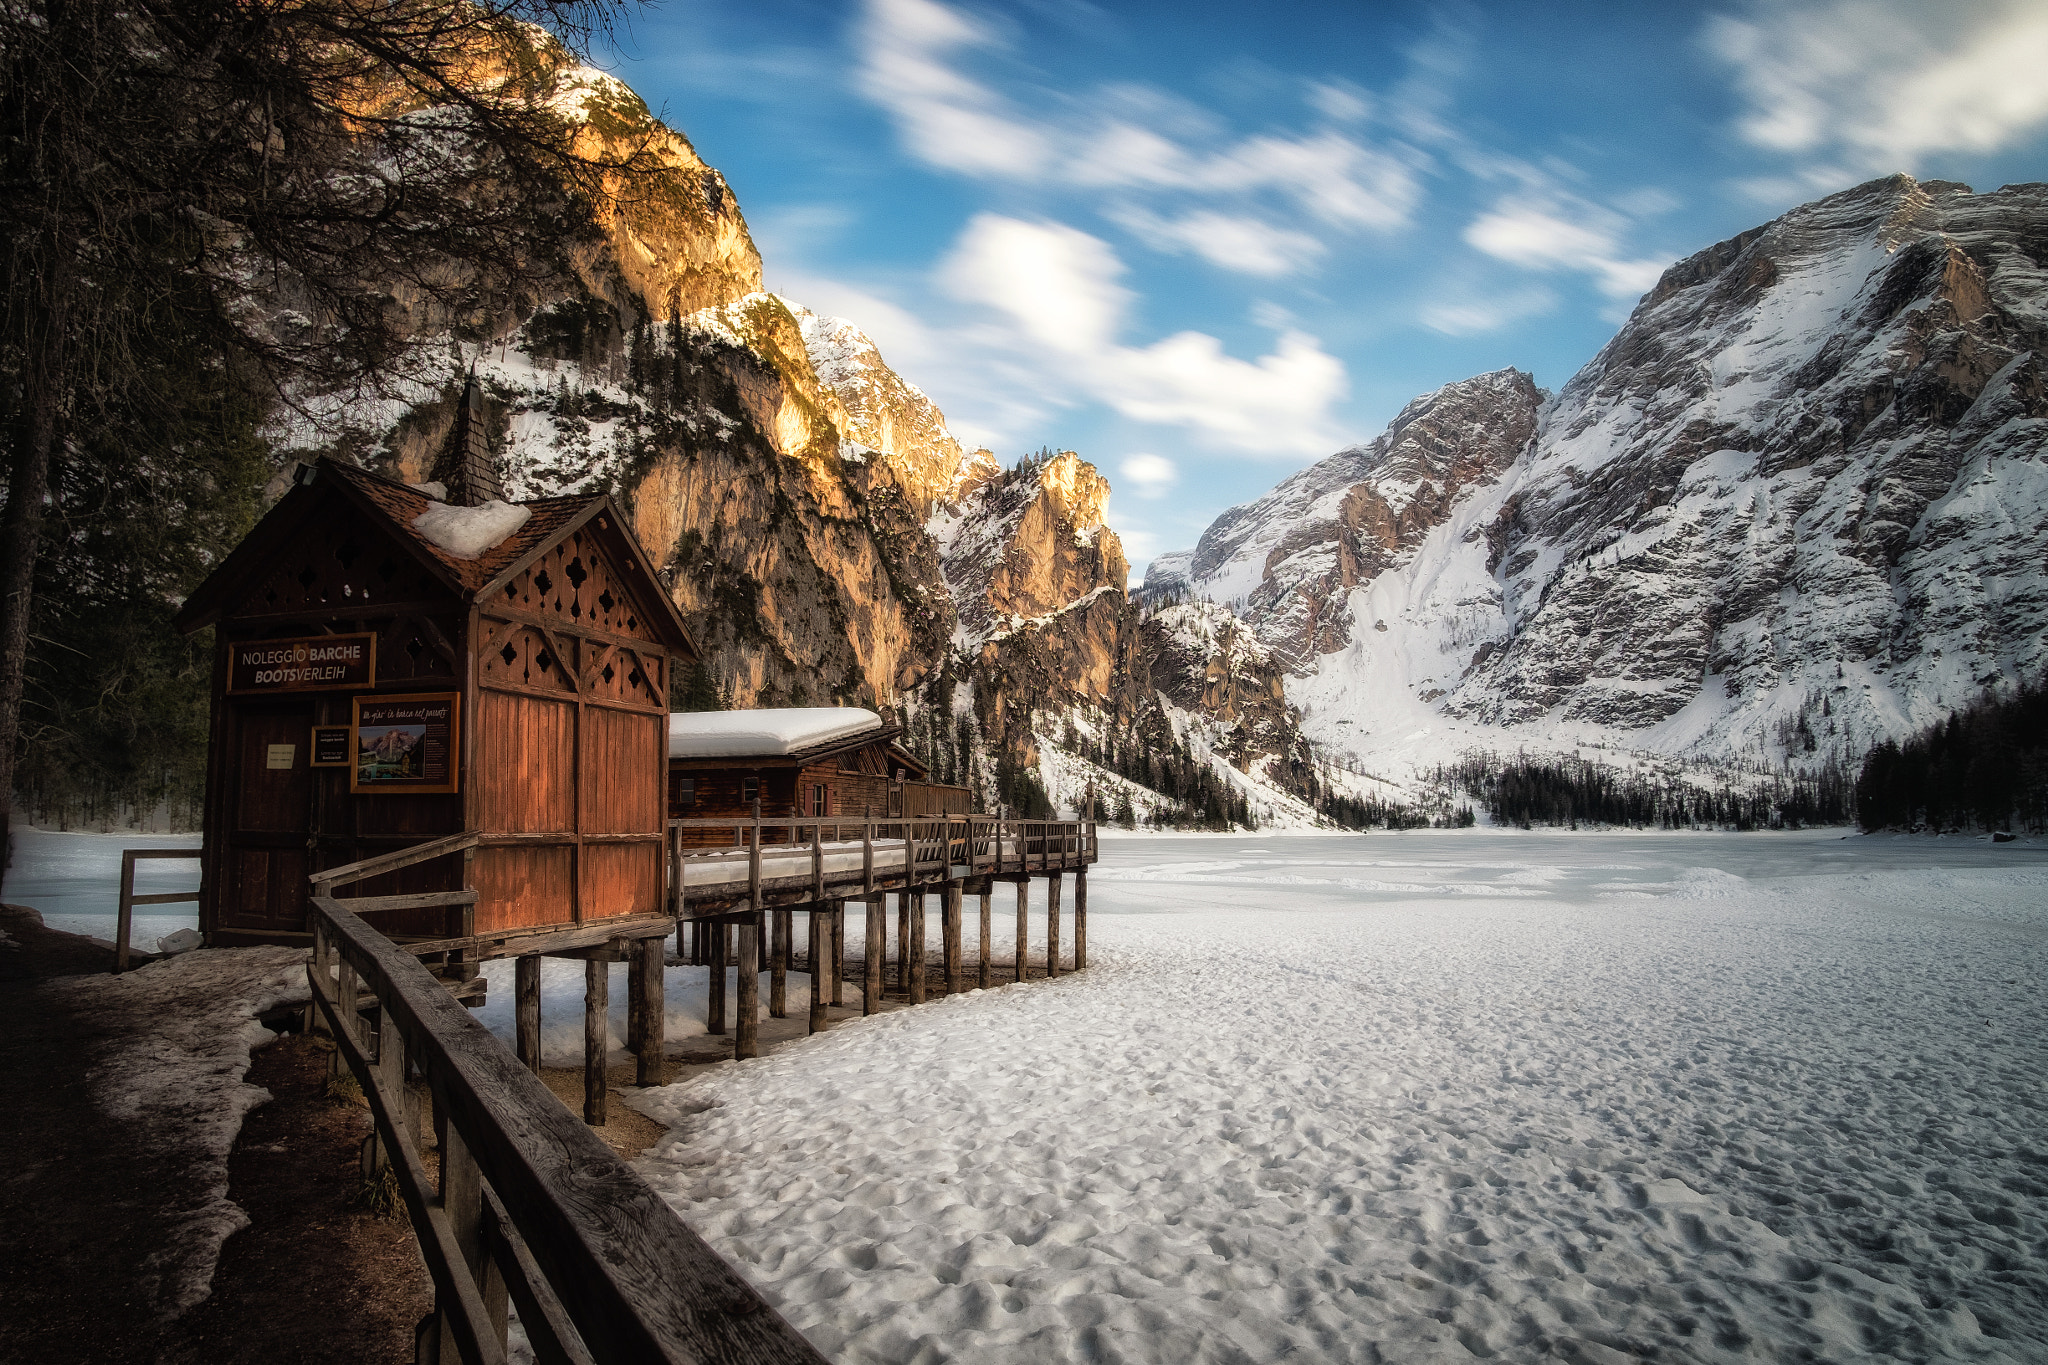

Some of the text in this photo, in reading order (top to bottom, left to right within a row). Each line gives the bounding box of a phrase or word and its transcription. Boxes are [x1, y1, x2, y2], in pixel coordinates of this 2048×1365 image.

[241, 645, 361, 666] NOLEGGIO BARCHE
[254, 665, 347, 684] BOOTSVERLEIH
